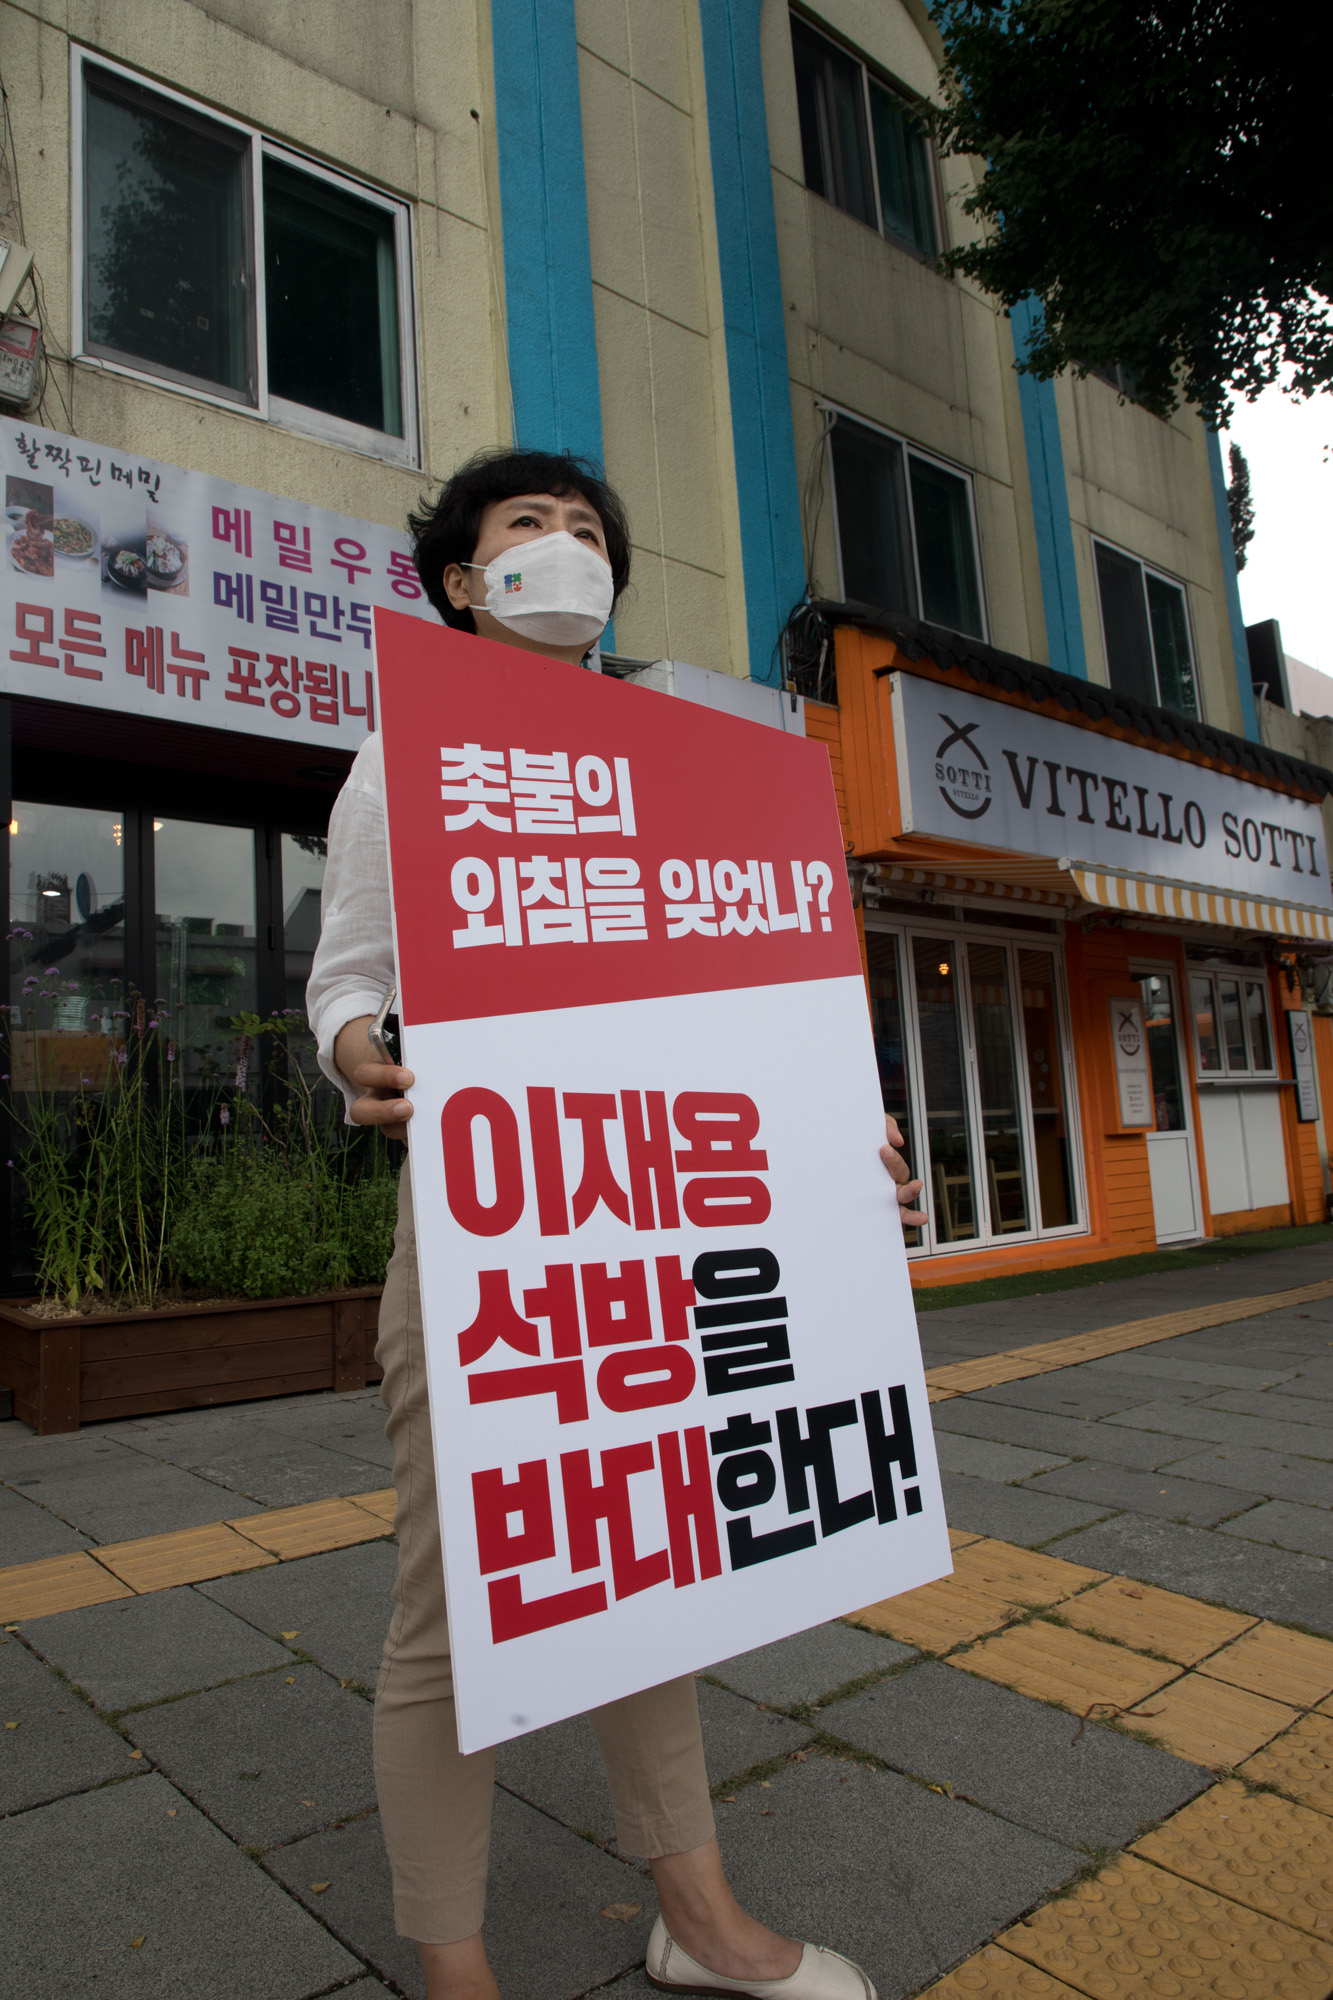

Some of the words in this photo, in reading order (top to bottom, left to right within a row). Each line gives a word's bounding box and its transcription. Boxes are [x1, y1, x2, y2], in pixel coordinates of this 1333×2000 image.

[212, 505, 422, 600] 메밀우동
[213, 571, 423, 650] 메밀만두
[9, 602, 107, 681] 모든
[125, 626, 209, 701] 메뉴
[224, 646, 375, 732] 포장됩니
[440, 743, 637, 836] 촛불의
[935, 762, 992, 793] SOTTI
[952, 788, 980, 801] VITELLO
[1002, 750, 1206, 849] VITELLO
[1222, 811, 1321, 877] SOTTI
[450, 855, 648, 949] 외침을
[659, 859, 834, 939] 잊었나?
[440, 1085, 771, 1237] 이재용
[457, 1247, 795, 1425] 석방을
[471, 1383, 923, 1645] 반대한다!
